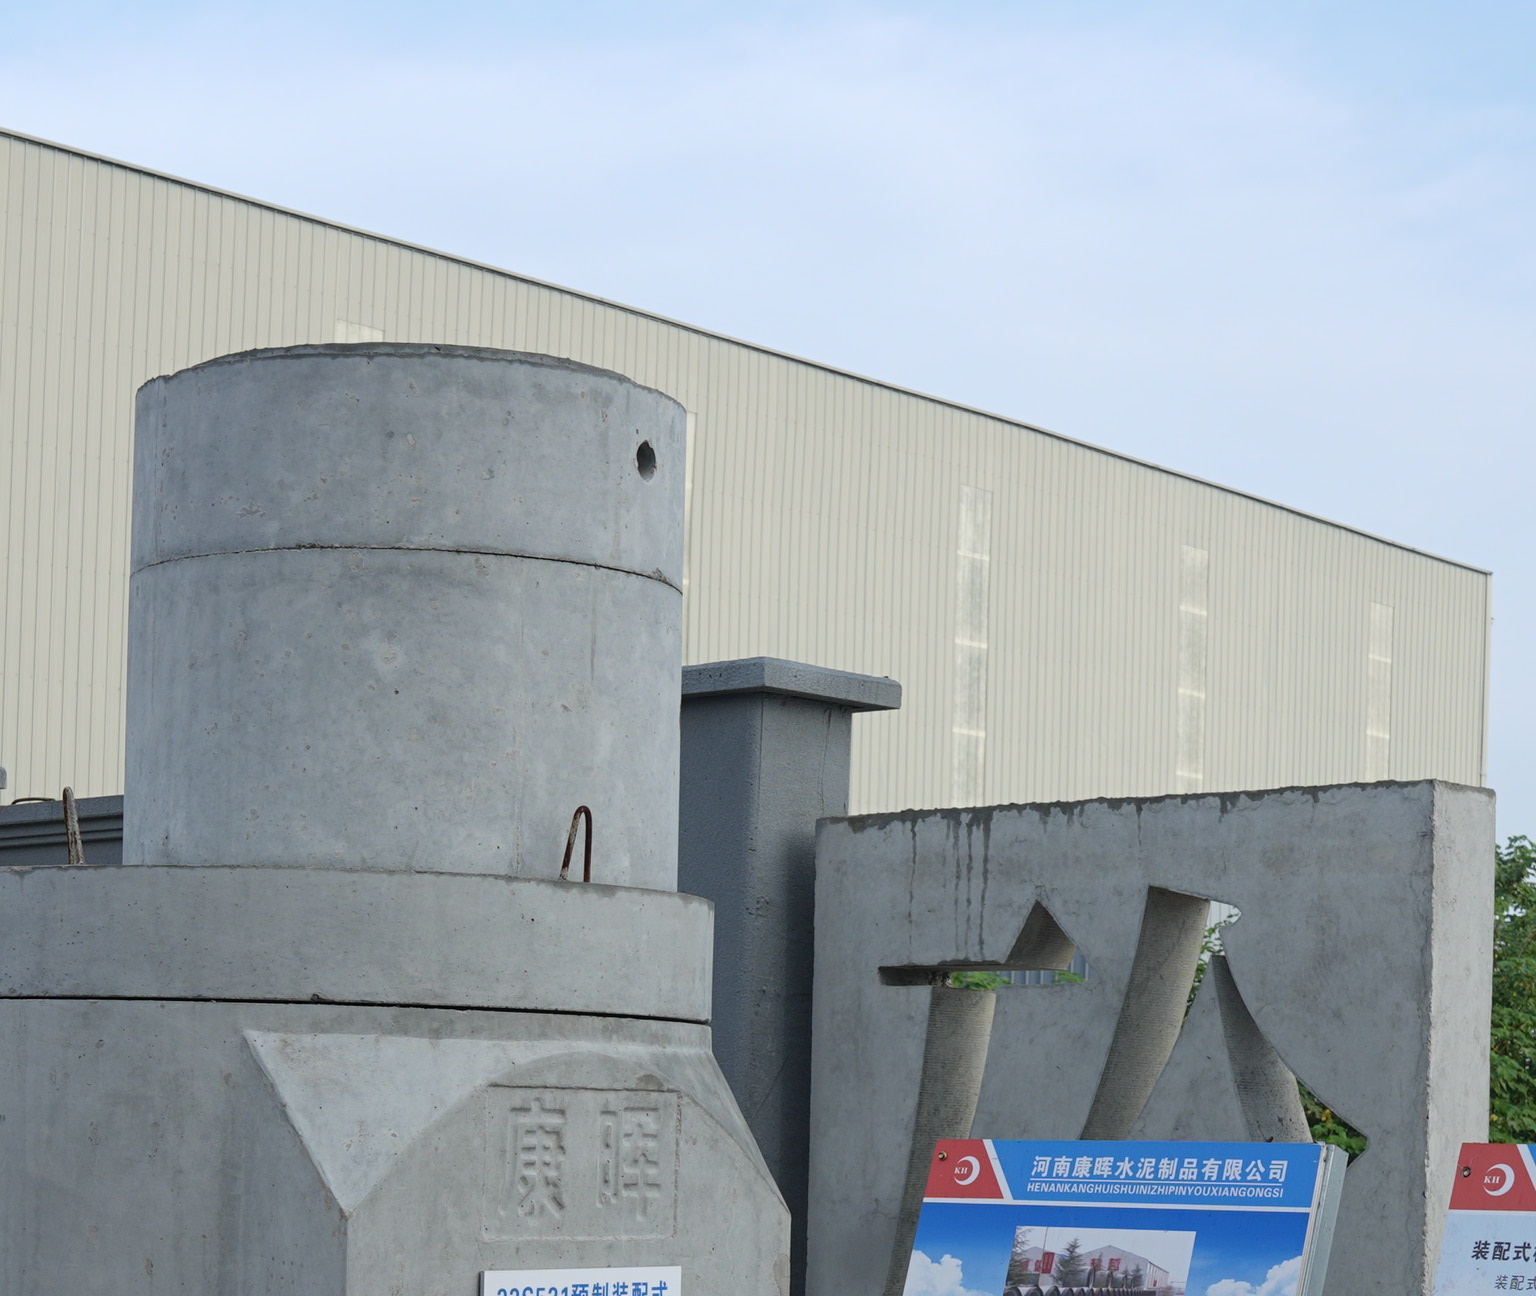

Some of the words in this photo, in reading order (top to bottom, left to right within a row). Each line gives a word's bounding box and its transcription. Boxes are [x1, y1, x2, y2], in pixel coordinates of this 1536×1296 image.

[1030, 1155, 1288, 1183] 河南康晖水泥制品有限公司
[1027, 1183, 1283, 1197] HENANKANGHUISHUINIZHIPINYOUXIANGONGSI
